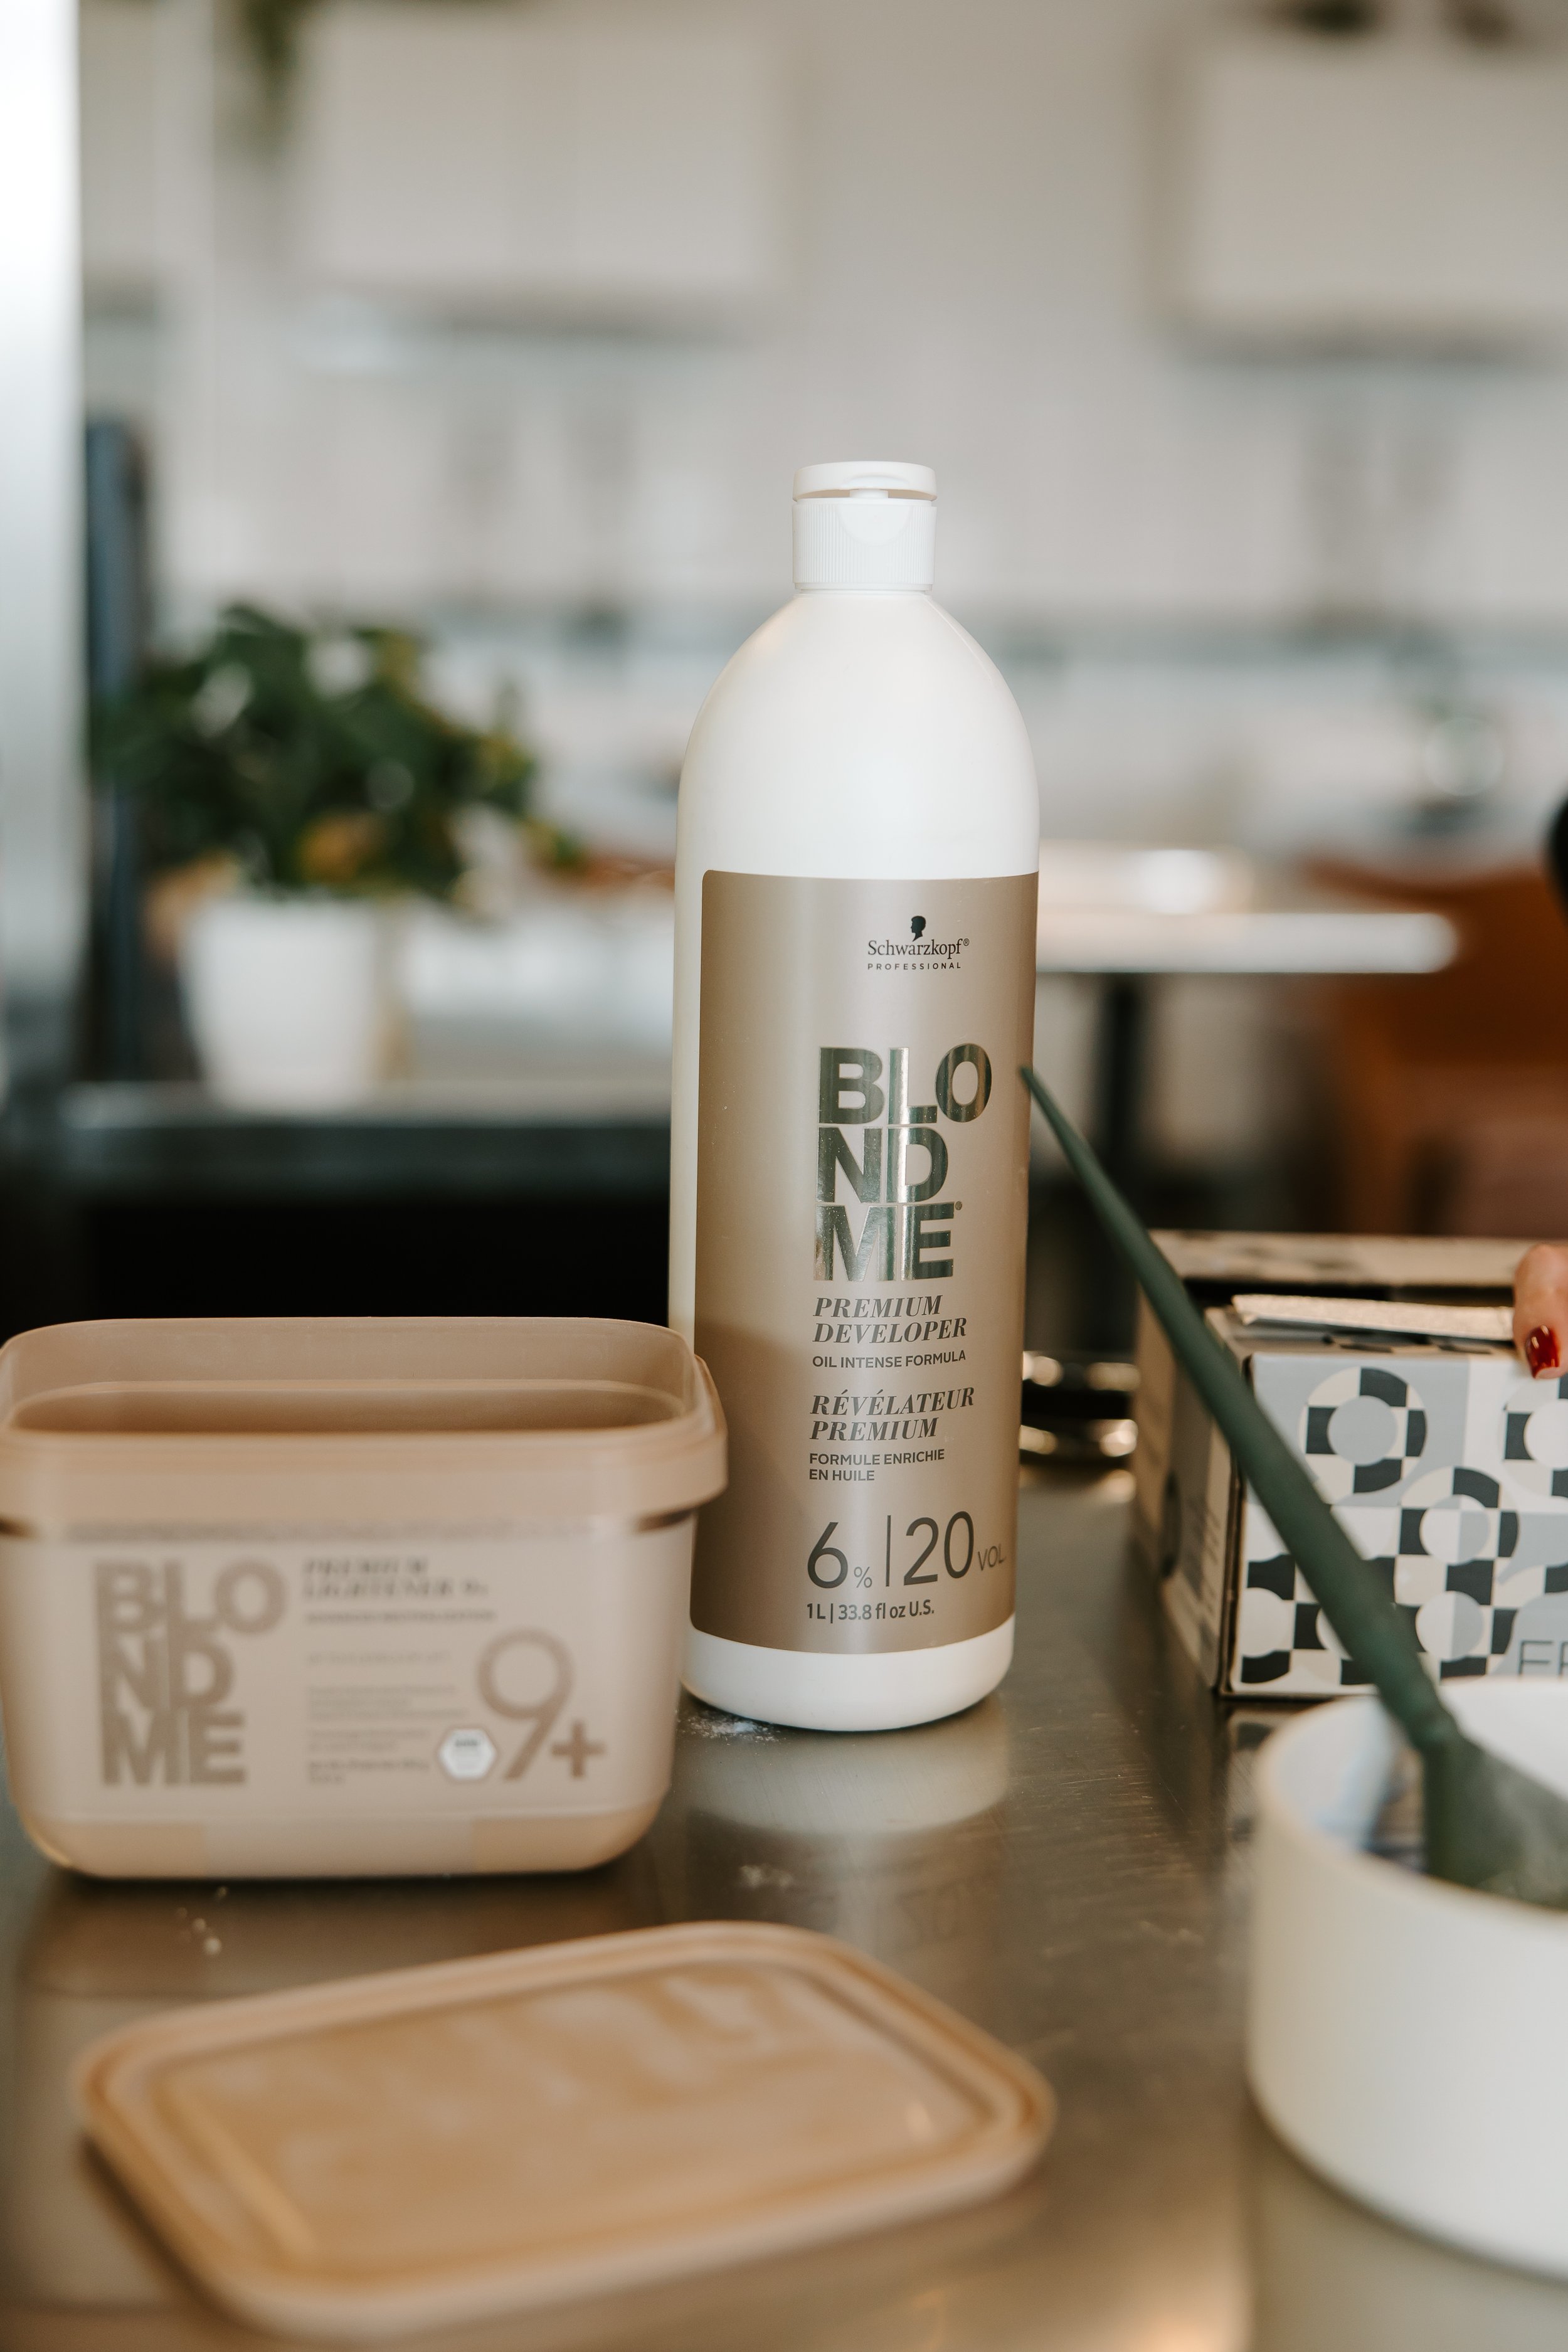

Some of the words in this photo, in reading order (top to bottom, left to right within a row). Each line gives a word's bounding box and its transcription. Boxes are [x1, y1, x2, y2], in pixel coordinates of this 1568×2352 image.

[867, 962, 961, 970] PROFESSIONAL
[818, 1043, 993, 1125] BLO
[817, 1126, 949, 1204] ND
[812, 1295, 943, 1318] PREMIUM
[812, 1317, 967, 1344] DEVELOPER
[812, 1356, 837, 1368] OIL
[840, 1356, 903, 1369] INTENSE
[906, 1350, 967, 1367] FORMULA
[810, 1387, 975, 1416] RÉVÉLATEUR
[809, 1417, 940, 1441] PREMIUM
[809, 1453, 881, 1466] FORMULE
[884, 1449, 945, 1465] ENRICHIE
[809, 1468, 829, 1481] EN
[832, 1470, 875, 1481] HUILE
[93, 1559, 288, 1636] BLO
[875, 1602, 886, 1620] fl
[889, 1605, 906, 1619] oz
[909, 1599, 935, 1617] U.S.
[98, 1633, 236, 1711] ND
[477, 1628, 607, 1781] 9+
[102, 1710, 246, 1786] ME
